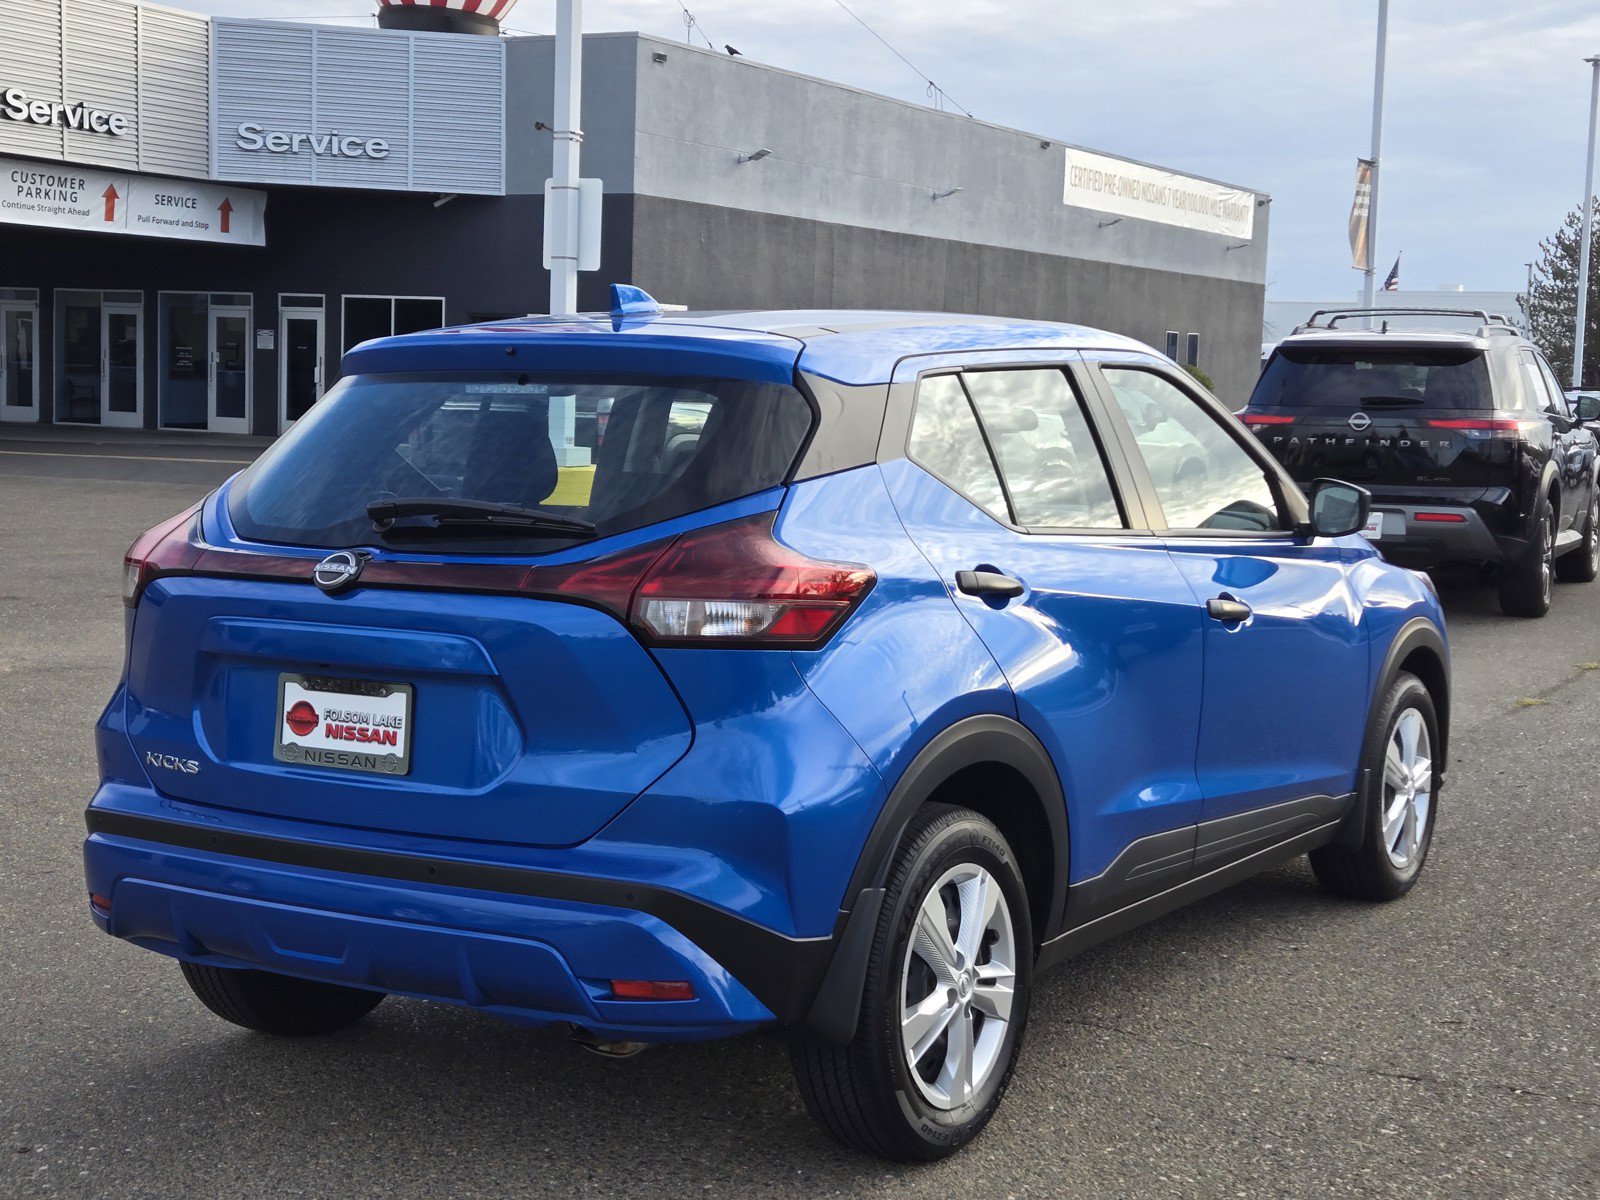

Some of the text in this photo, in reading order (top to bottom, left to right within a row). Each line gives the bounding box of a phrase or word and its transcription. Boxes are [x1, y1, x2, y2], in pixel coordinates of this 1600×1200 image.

[5, 88, 128, 135] Service
[236, 121, 390, 158] Service
[11, 170, 85, 190] CUSTOMER
[1070, 165, 1103, 192] CERTIFIED
[1104, 172, 1140, 200] PRE-OWNED
[17, 185, 78, 203] PARKING
[154, 194, 197, 209] SERVICE
[2, 200, 90, 216] Continue Straight Ahead
[137, 214, 209, 230] Pull Forward and Stop
[1273, 436, 1450, 448] PATHFINDER
[315, 563, 356, 574] NISSAN
[323, 708, 402, 728] FOLSOM LAKE
[325, 723, 397, 746] NISSAN
[146, 751, 199, 774] KICKS
[304, 750, 376, 769] NISSAN
